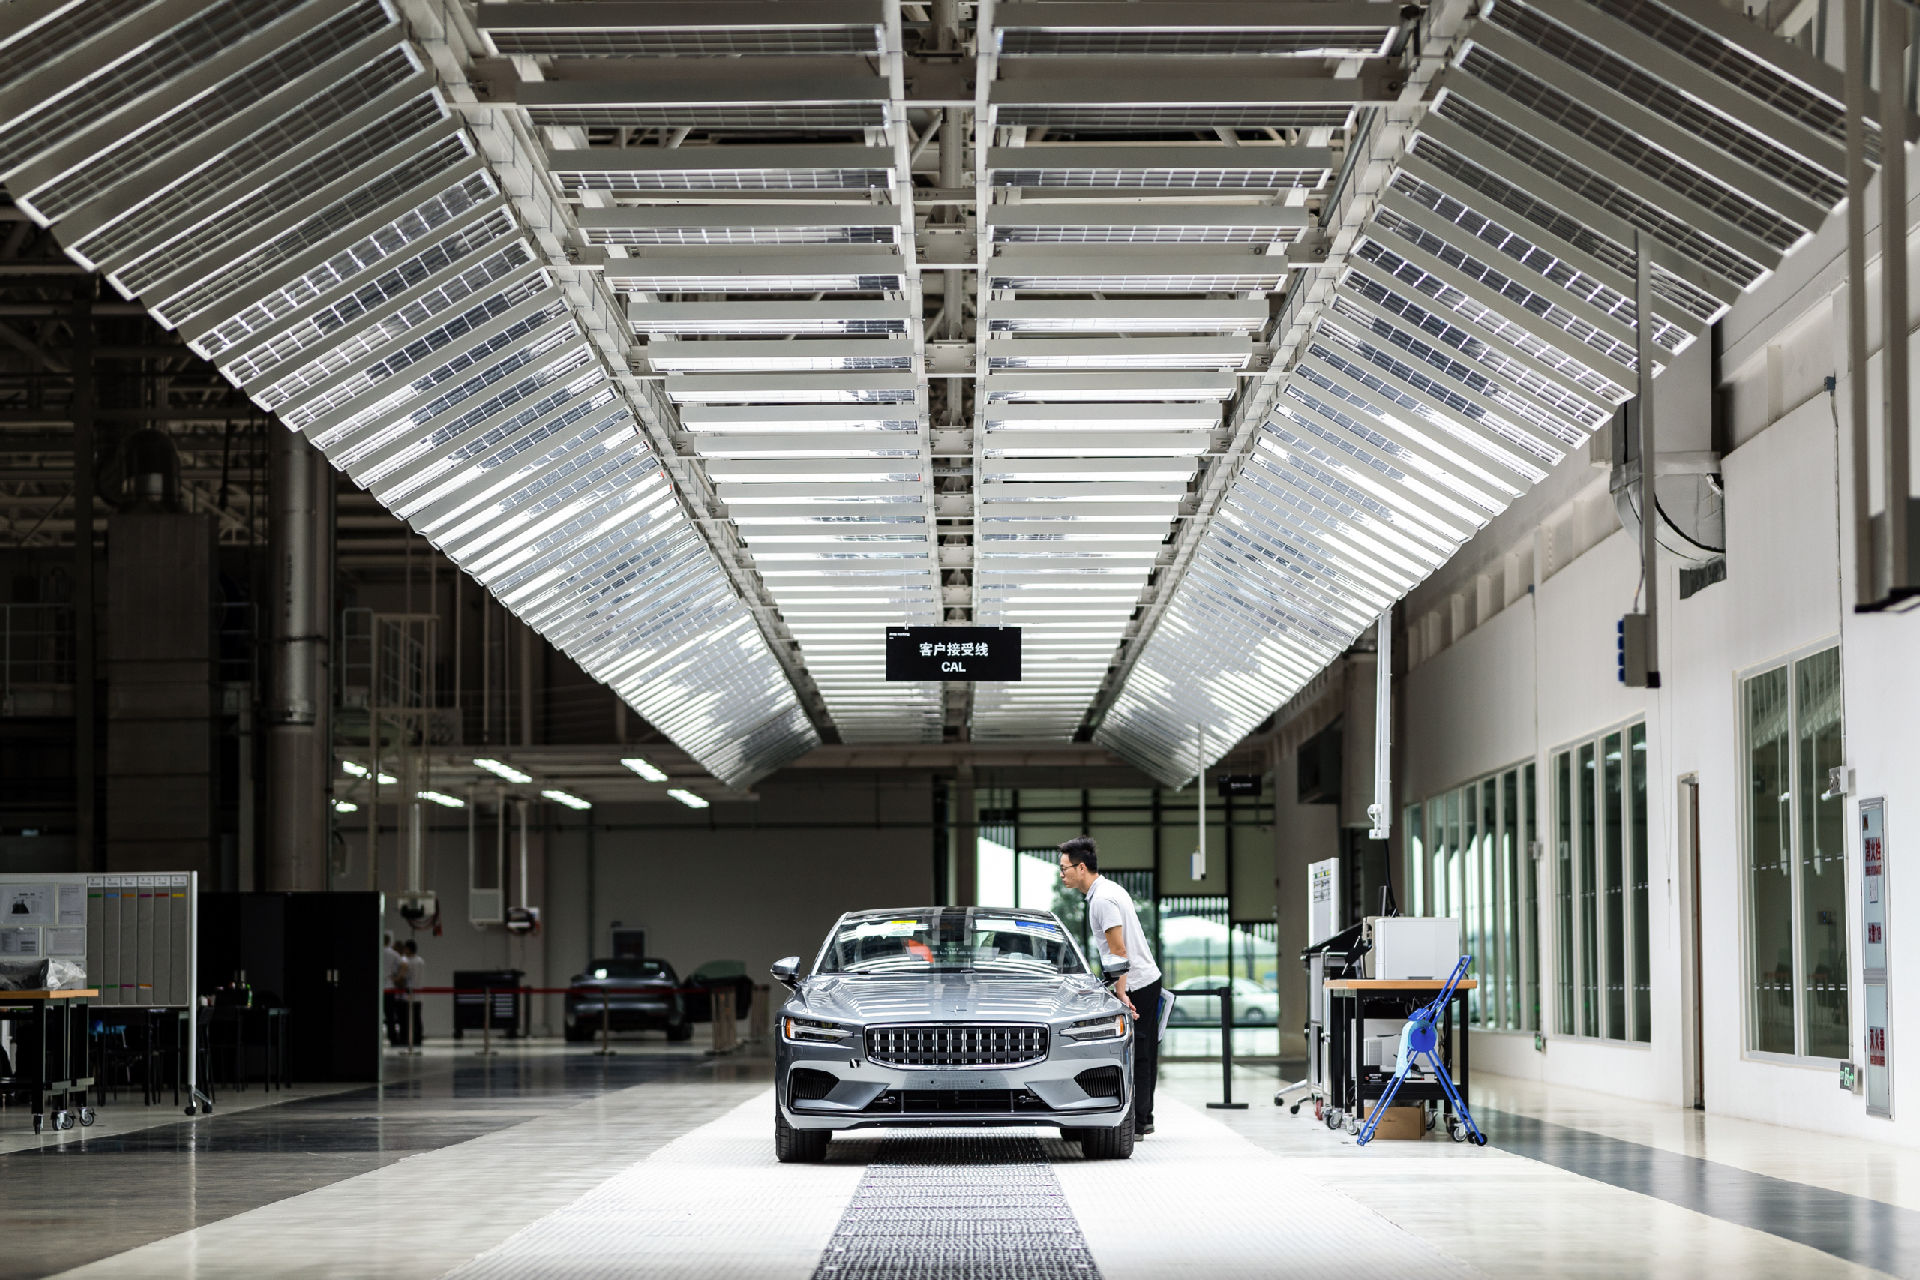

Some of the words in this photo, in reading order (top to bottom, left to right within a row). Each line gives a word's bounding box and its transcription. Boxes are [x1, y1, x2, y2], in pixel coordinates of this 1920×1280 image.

[919, 642, 989, 657] 客户接受线
[941, 661, 966, 672] CAL
